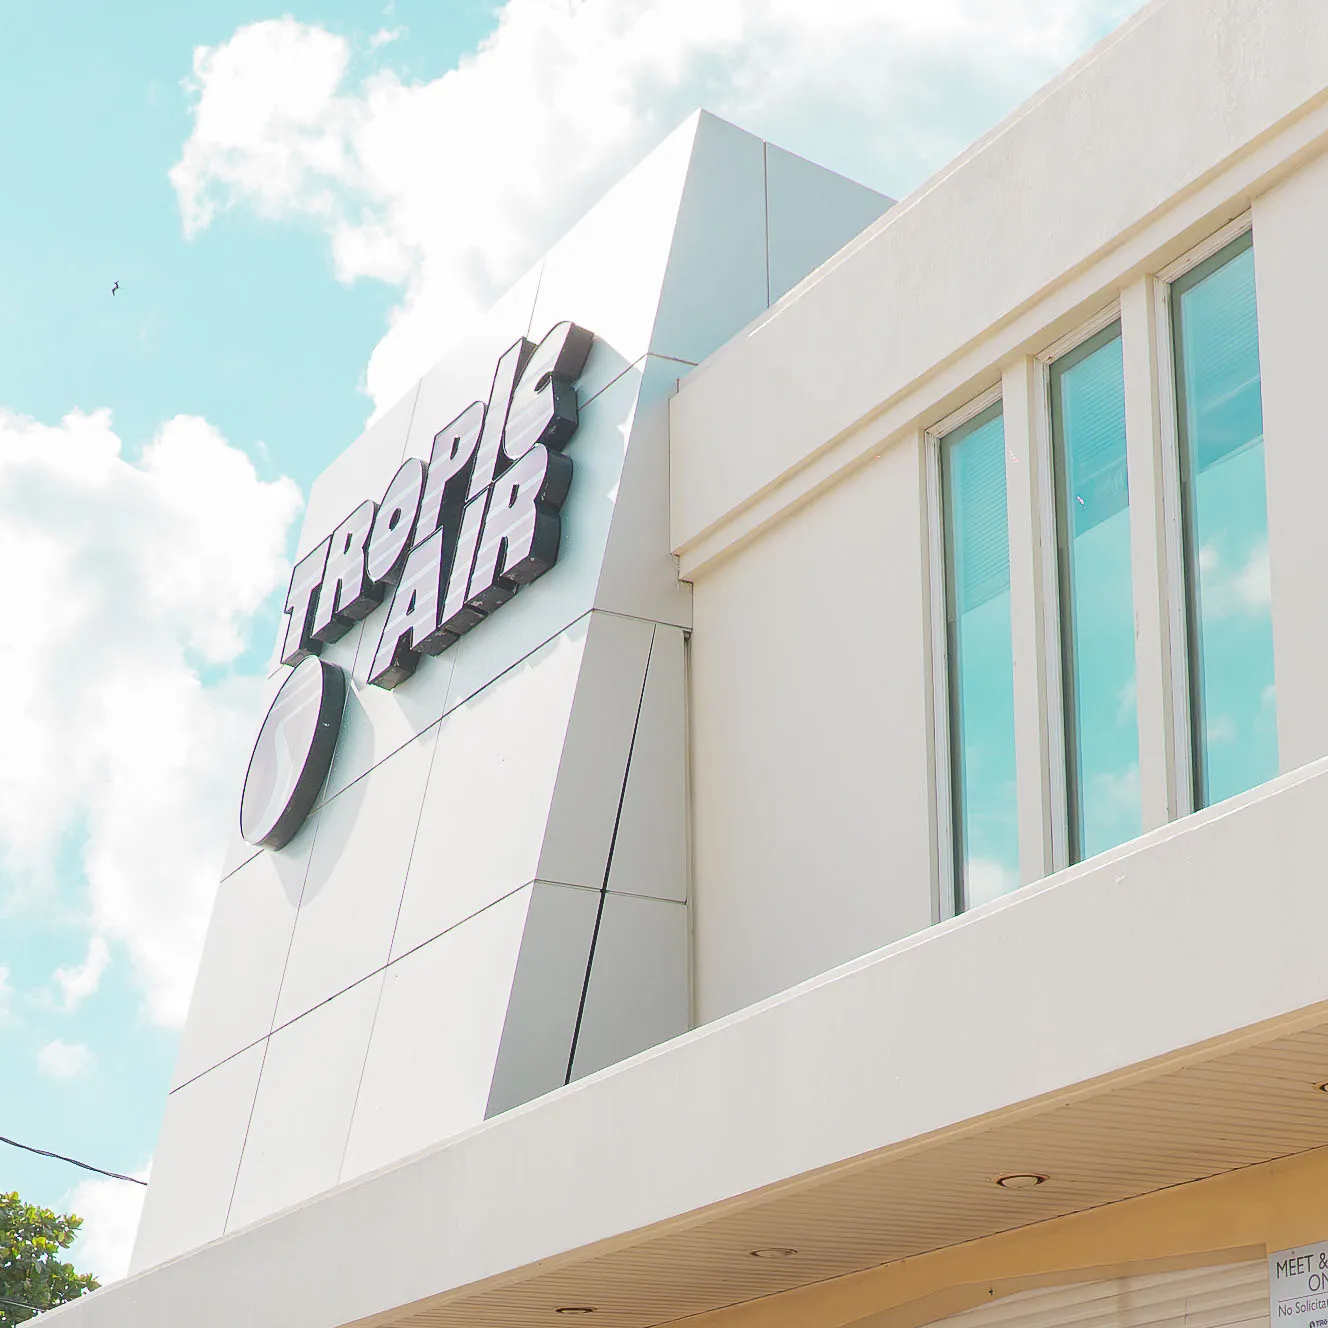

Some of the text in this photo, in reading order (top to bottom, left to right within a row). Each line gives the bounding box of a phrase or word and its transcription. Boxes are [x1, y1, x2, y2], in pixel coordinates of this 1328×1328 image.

[281, 321, 594, 668] TROPIC
[367, 443, 573, 691] AIR
[1276, 1255, 1314, 1279] MEET
[1318, 1252, 1328, 1270] &
[1278, 1304, 1293, 1317] No
